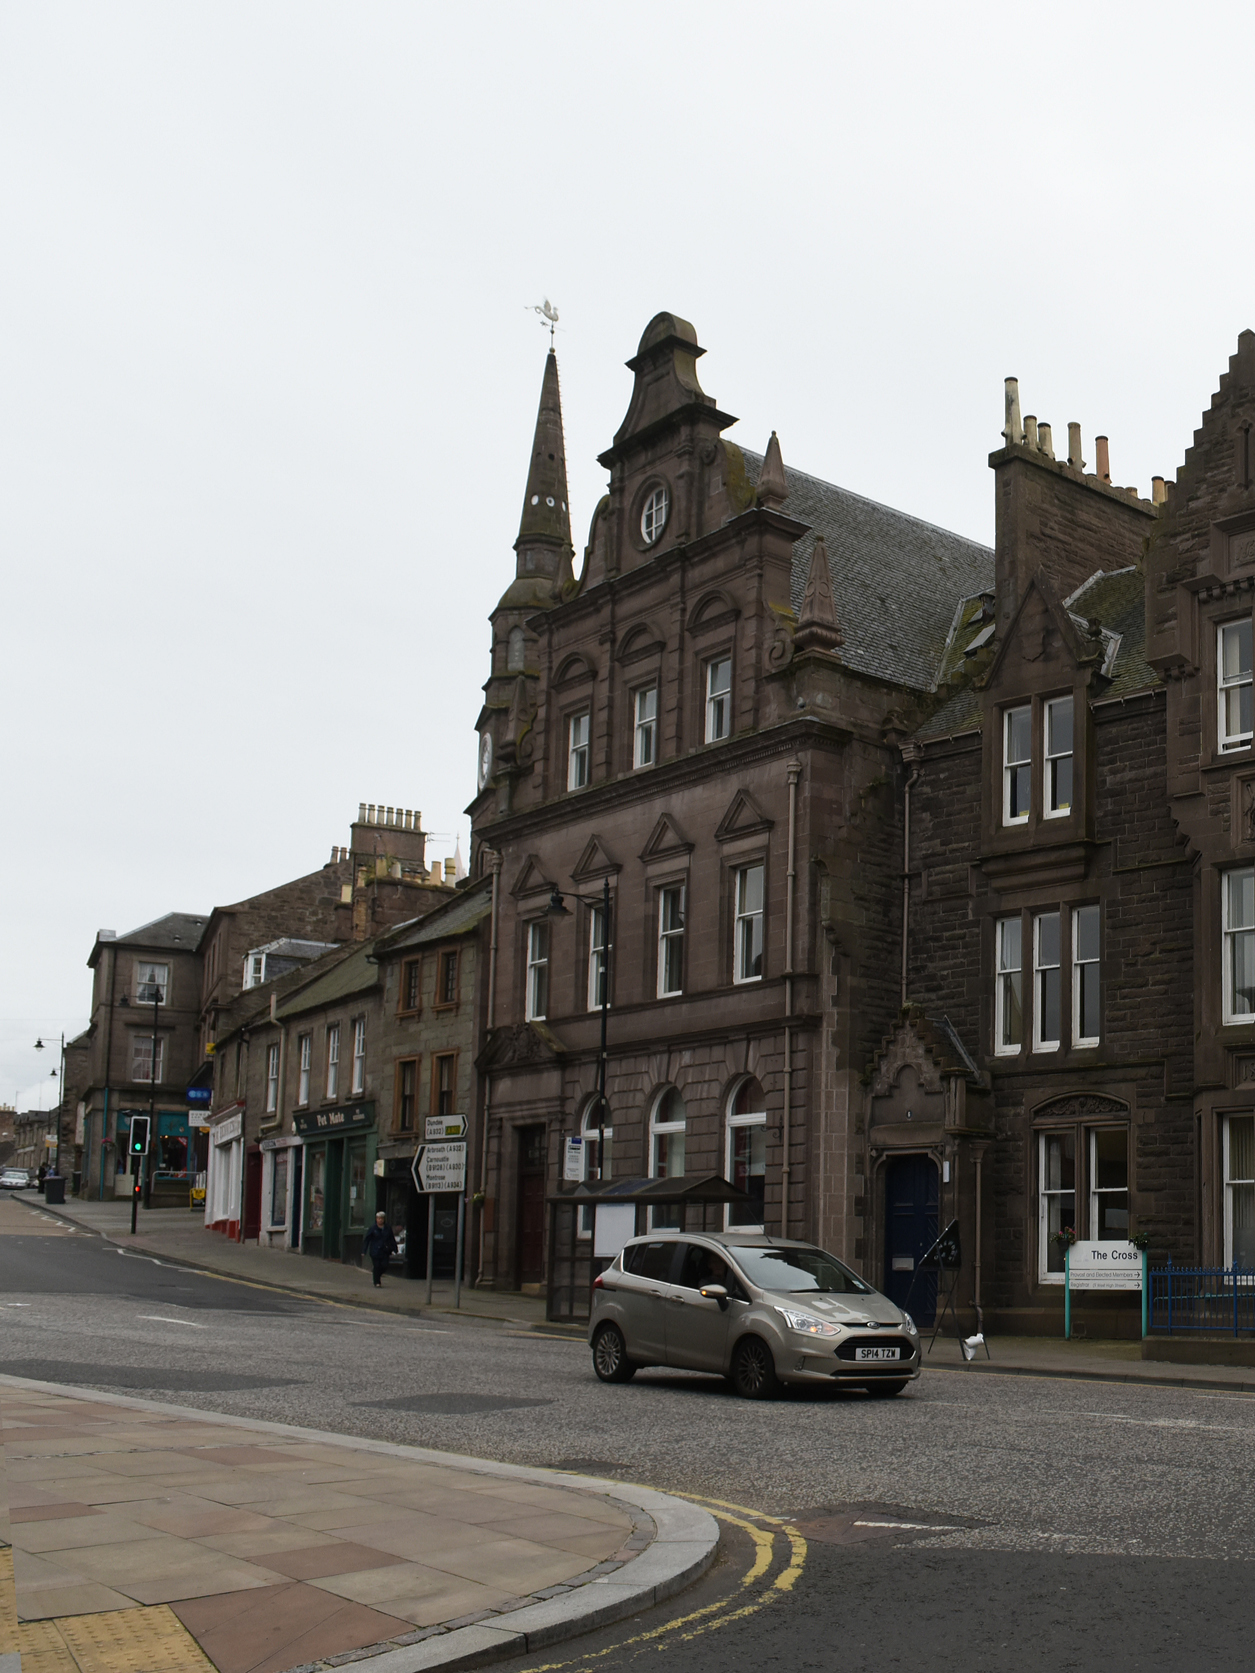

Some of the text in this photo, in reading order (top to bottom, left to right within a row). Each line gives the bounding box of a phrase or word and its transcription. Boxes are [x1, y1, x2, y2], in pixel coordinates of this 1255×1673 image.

[316, 1114, 328, 1127] Pet
[328, 1111, 345, 1125] Mate
[1091, 1250, 1138, 1260] The Cross
